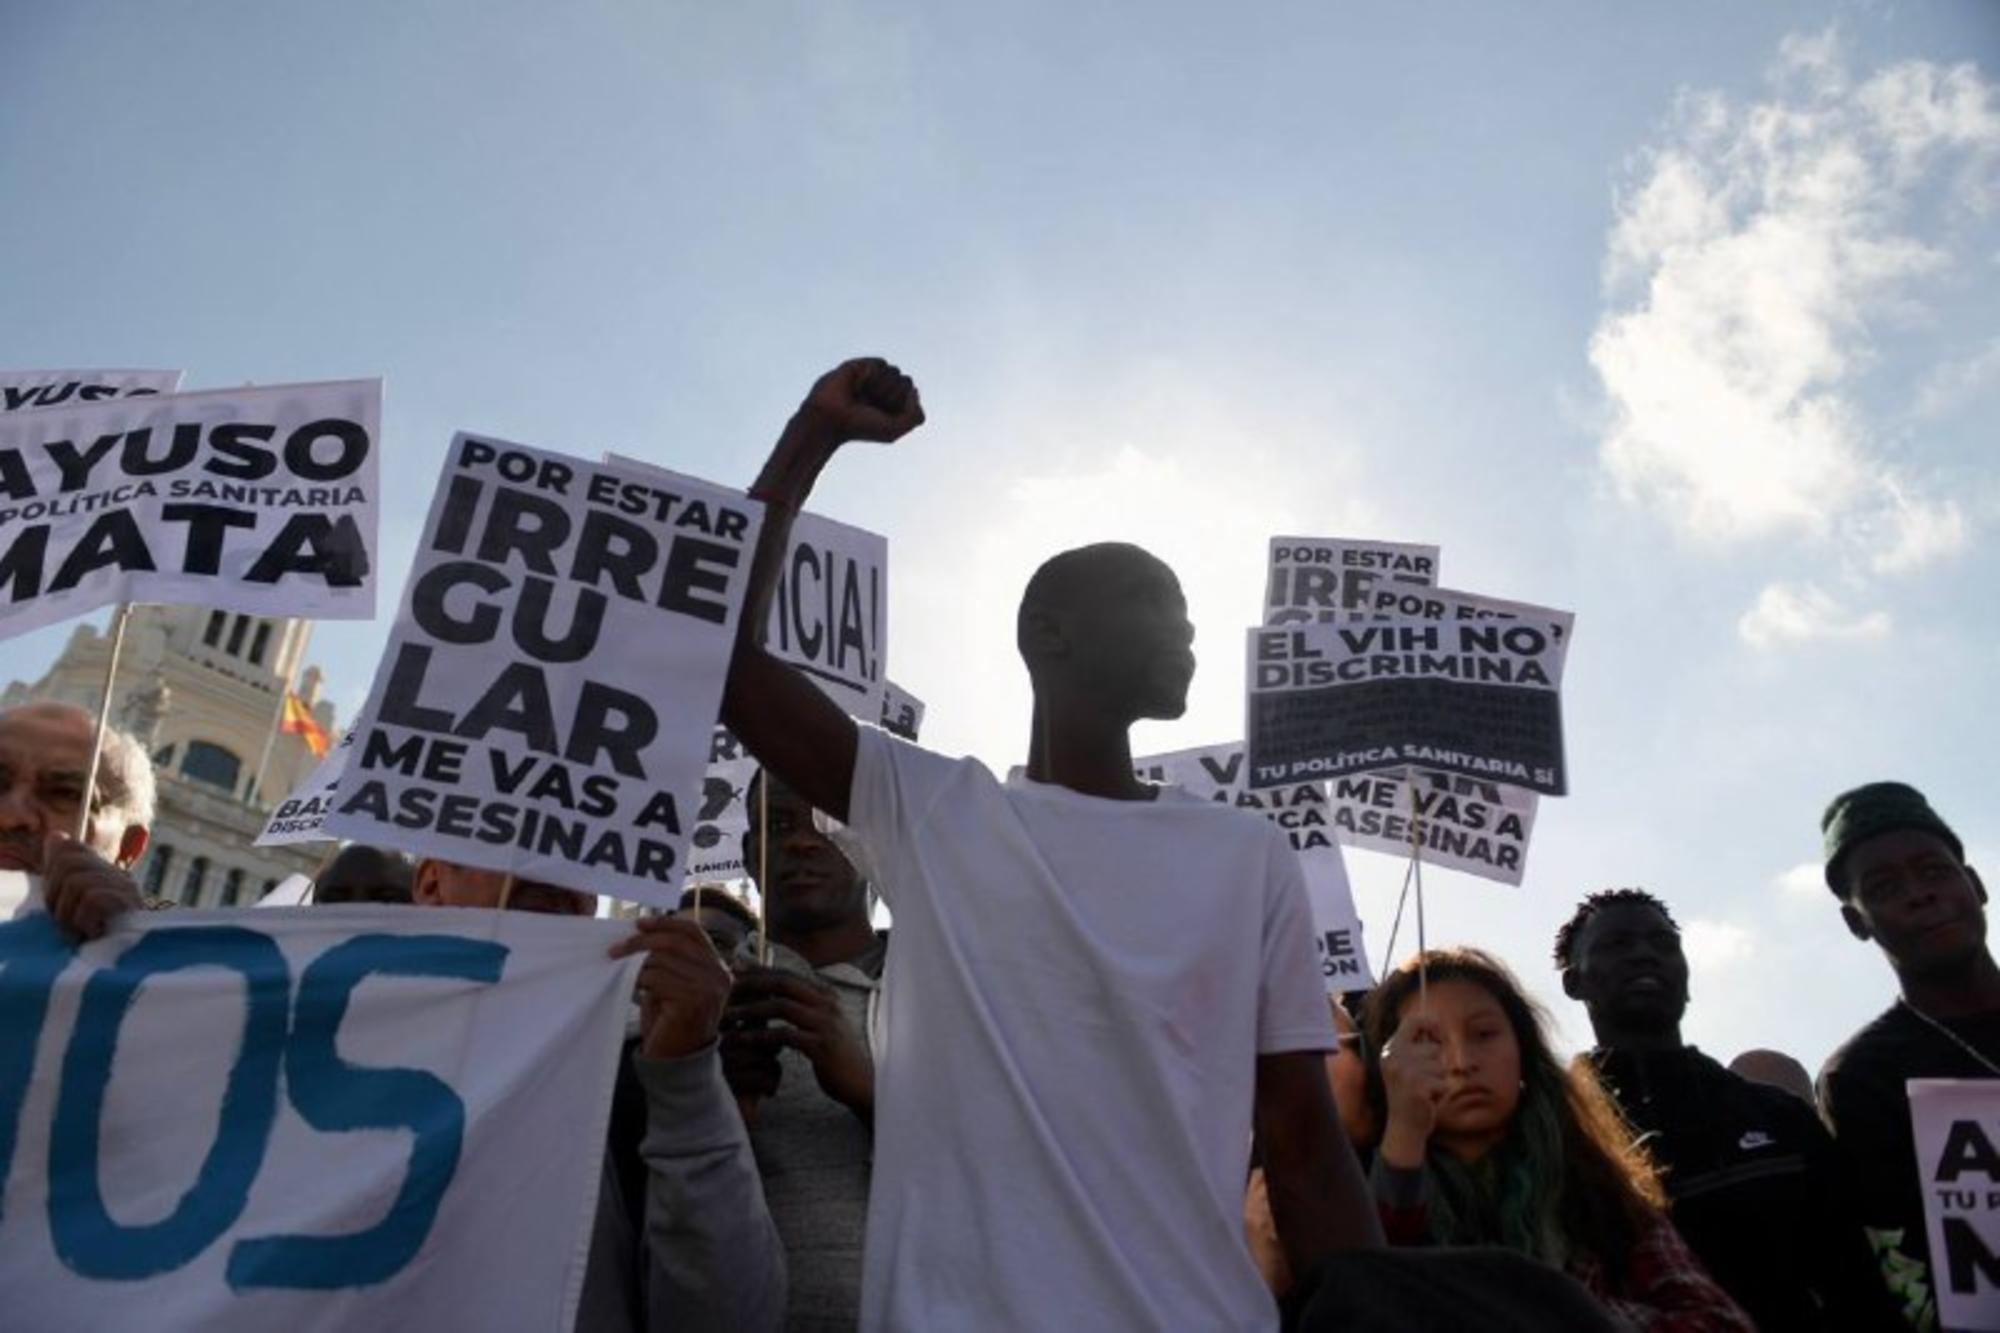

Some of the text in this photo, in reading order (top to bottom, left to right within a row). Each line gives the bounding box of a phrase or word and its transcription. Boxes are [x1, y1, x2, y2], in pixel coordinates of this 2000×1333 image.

[4, 381, 158, 410] YUS
[0, 480, 366, 525] POLÍTICA SANITARIA
[458, 439, 748, 541] POR ESTAR
[432, 475, 740, 626] IRRE
[1275, 547, 1432, 574] POR ESTAR
[412, 561, 607, 664] GU
[1375, 591, 1446, 620] POR
[1257, 630, 1322, 661] EL
[1339, 626, 1438, 655] VIH
[1459, 626, 1546, 656] NO
[1256, 655, 1551, 688] DISCRIMINA
[377, 643, 659, 780] LAR
[361, 728, 468, 784] ME
[489, 748, 619, 818] VAS
[634, 791, 681, 836] A
[1258, 744, 1556, 786] TU POLÍTICA SANITARIA SÍ
[338, 780, 676, 884] ASESINAR
[1337, 779, 1397, 808] ME
[1413, 787, 1486, 829] VAS
[1495, 812, 1524, 841] A
[1335, 806, 1520, 871] ASESINAR
[1936, 1190, 1976, 1210] TU
